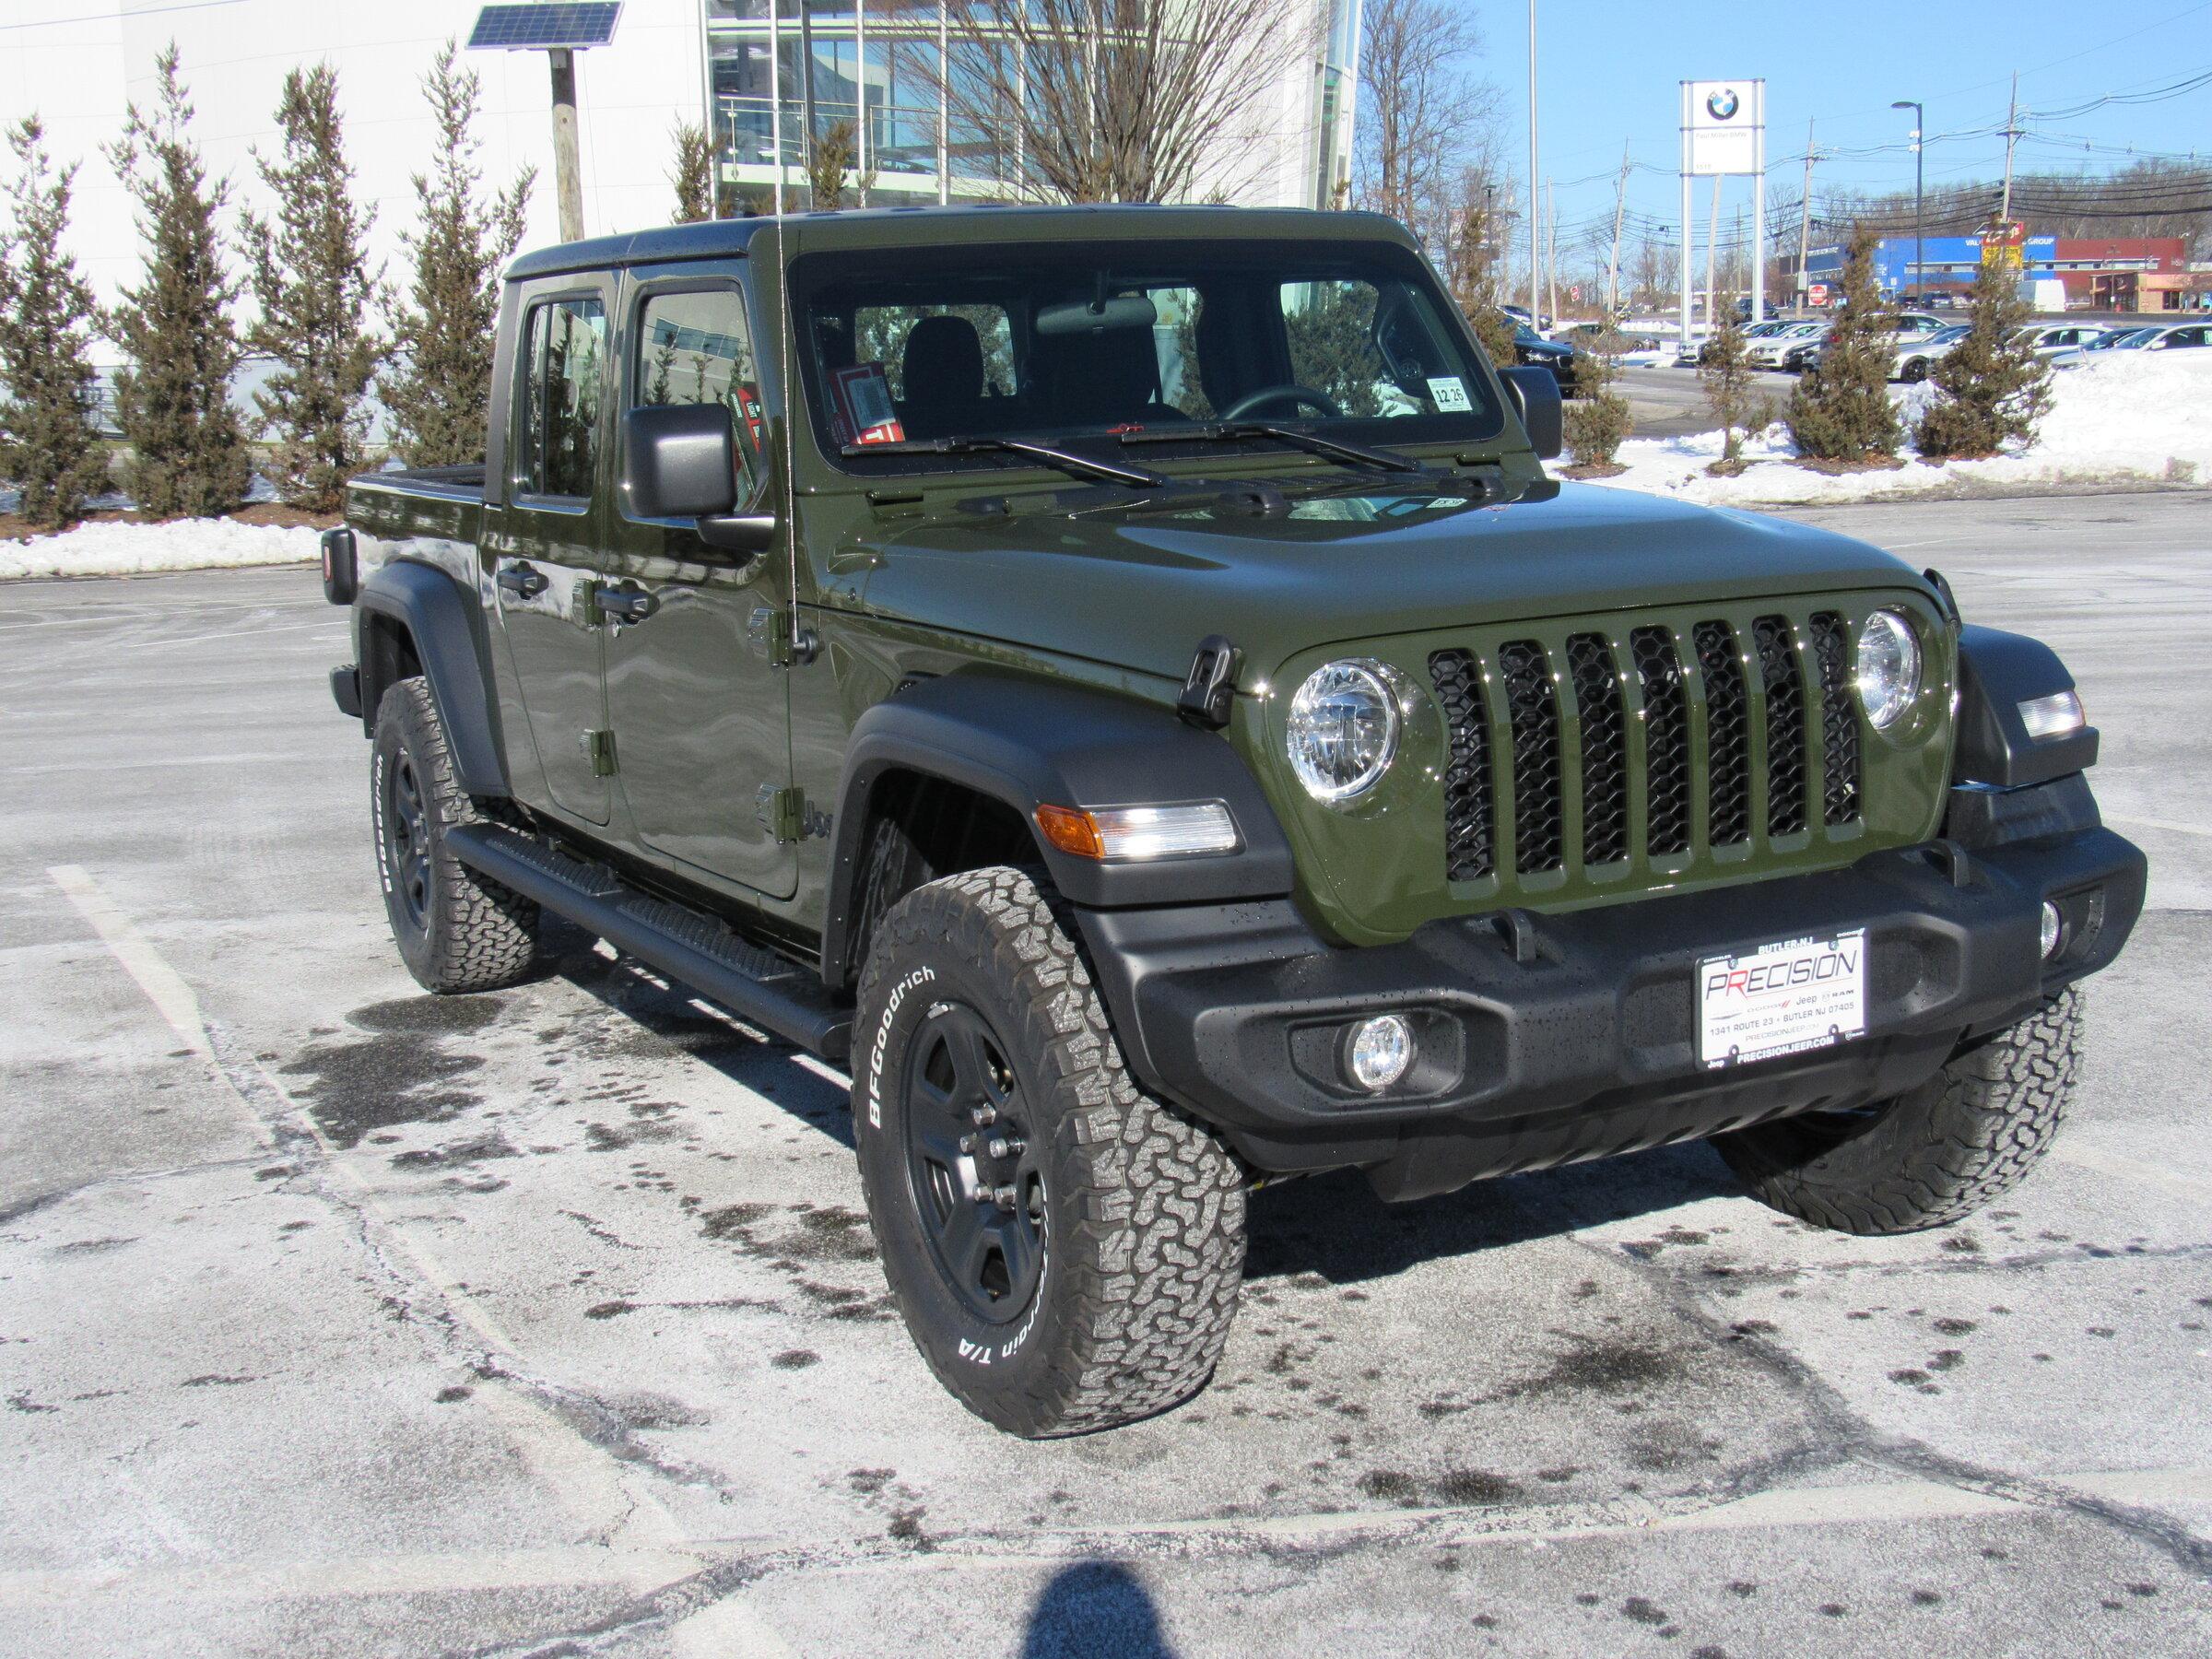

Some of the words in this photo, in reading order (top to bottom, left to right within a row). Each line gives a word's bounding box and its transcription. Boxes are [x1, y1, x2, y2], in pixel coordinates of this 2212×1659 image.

[1436, 389, 1451, 403] 12
[1451, 388, 1464, 401] 26
[376, 754, 393, 893] BFGoodrich
[1706, 950, 1858, 1001] PRECISION
[1796, 995, 1817, 1006] Jeep
[1711, 1026, 1731, 1036] 1341
[1734, 1020, 1760, 1032] ROUTE
[1763, 1018, 1773, 1026] 23
[1783, 1010, 1813, 1022] BUTLER
[1816, 1007, 1826, 1017] NJ
[1829, 1002, 1854, 1014] 07405
[868, 965, 935, 1130] BFGoodrich
[1737, 1035, 1834, 1064] PRECISIONJEEP.COM
[959, 1338, 992, 1364] T/A
